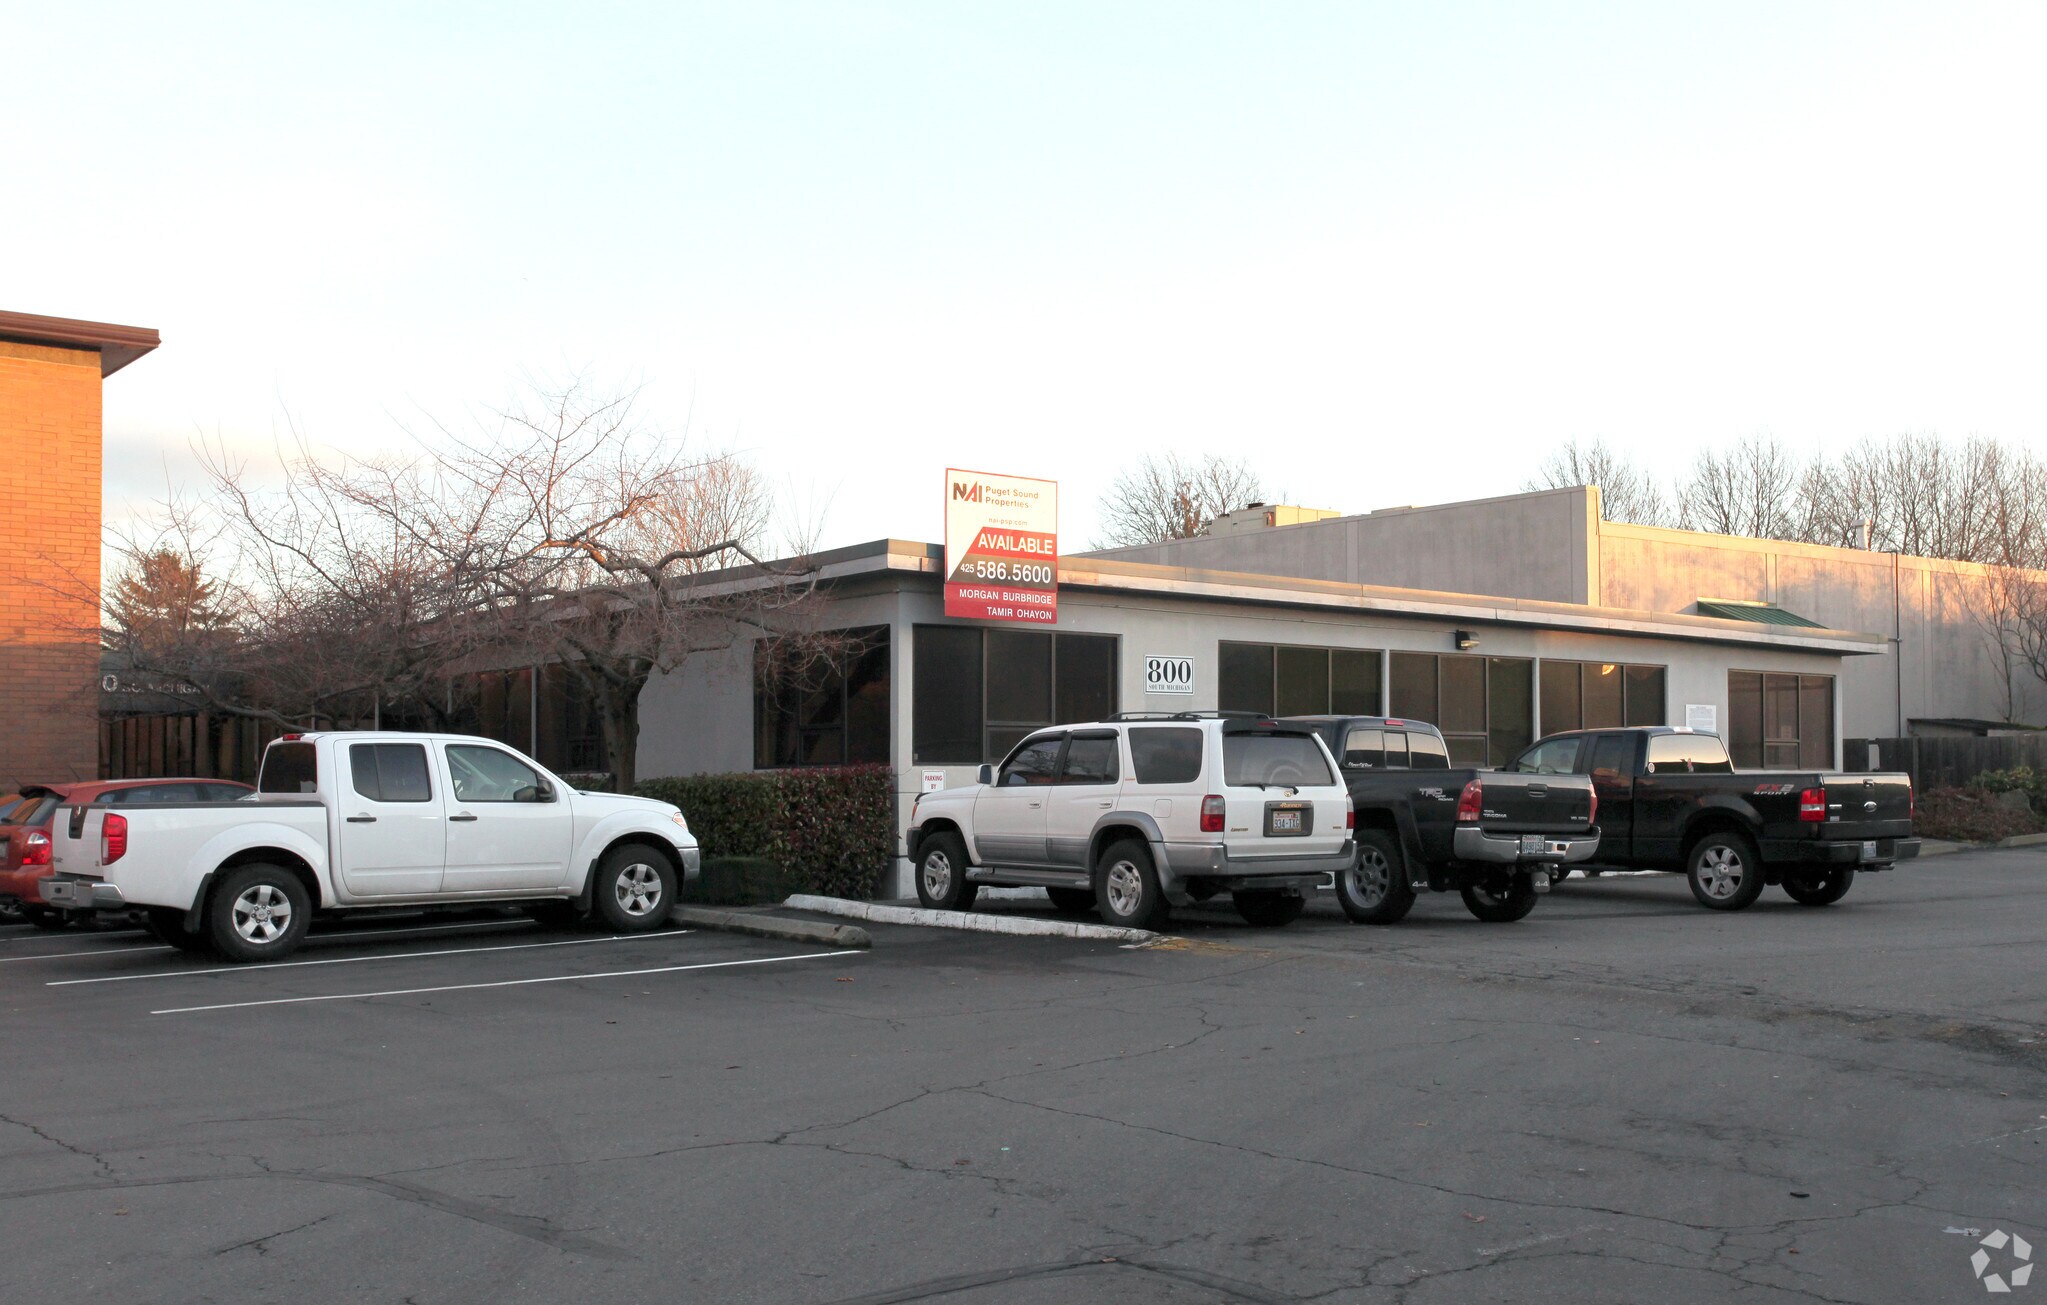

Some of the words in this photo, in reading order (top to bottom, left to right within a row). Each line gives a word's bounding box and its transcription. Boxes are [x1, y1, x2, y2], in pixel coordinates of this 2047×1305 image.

[953, 481, 983, 503] NAI
[985, 485, 1010, 497] Puget
[1013, 488, 1039, 499] Sound
[985, 496, 1030, 509] Properties
[977, 532, 1053, 555] AVAILABLE
[960, 563, 975, 574] 425
[976, 561, 1052, 584] 586.5600
[959, 588, 999, 601] MORGAN
[1003, 591, 1052, 605] BURBRIDGE
[987, 606, 1013, 617] TAMIR
[1016, 609, 1052, 620] OHAYON
[1148, 659, 1191, 683] 800
